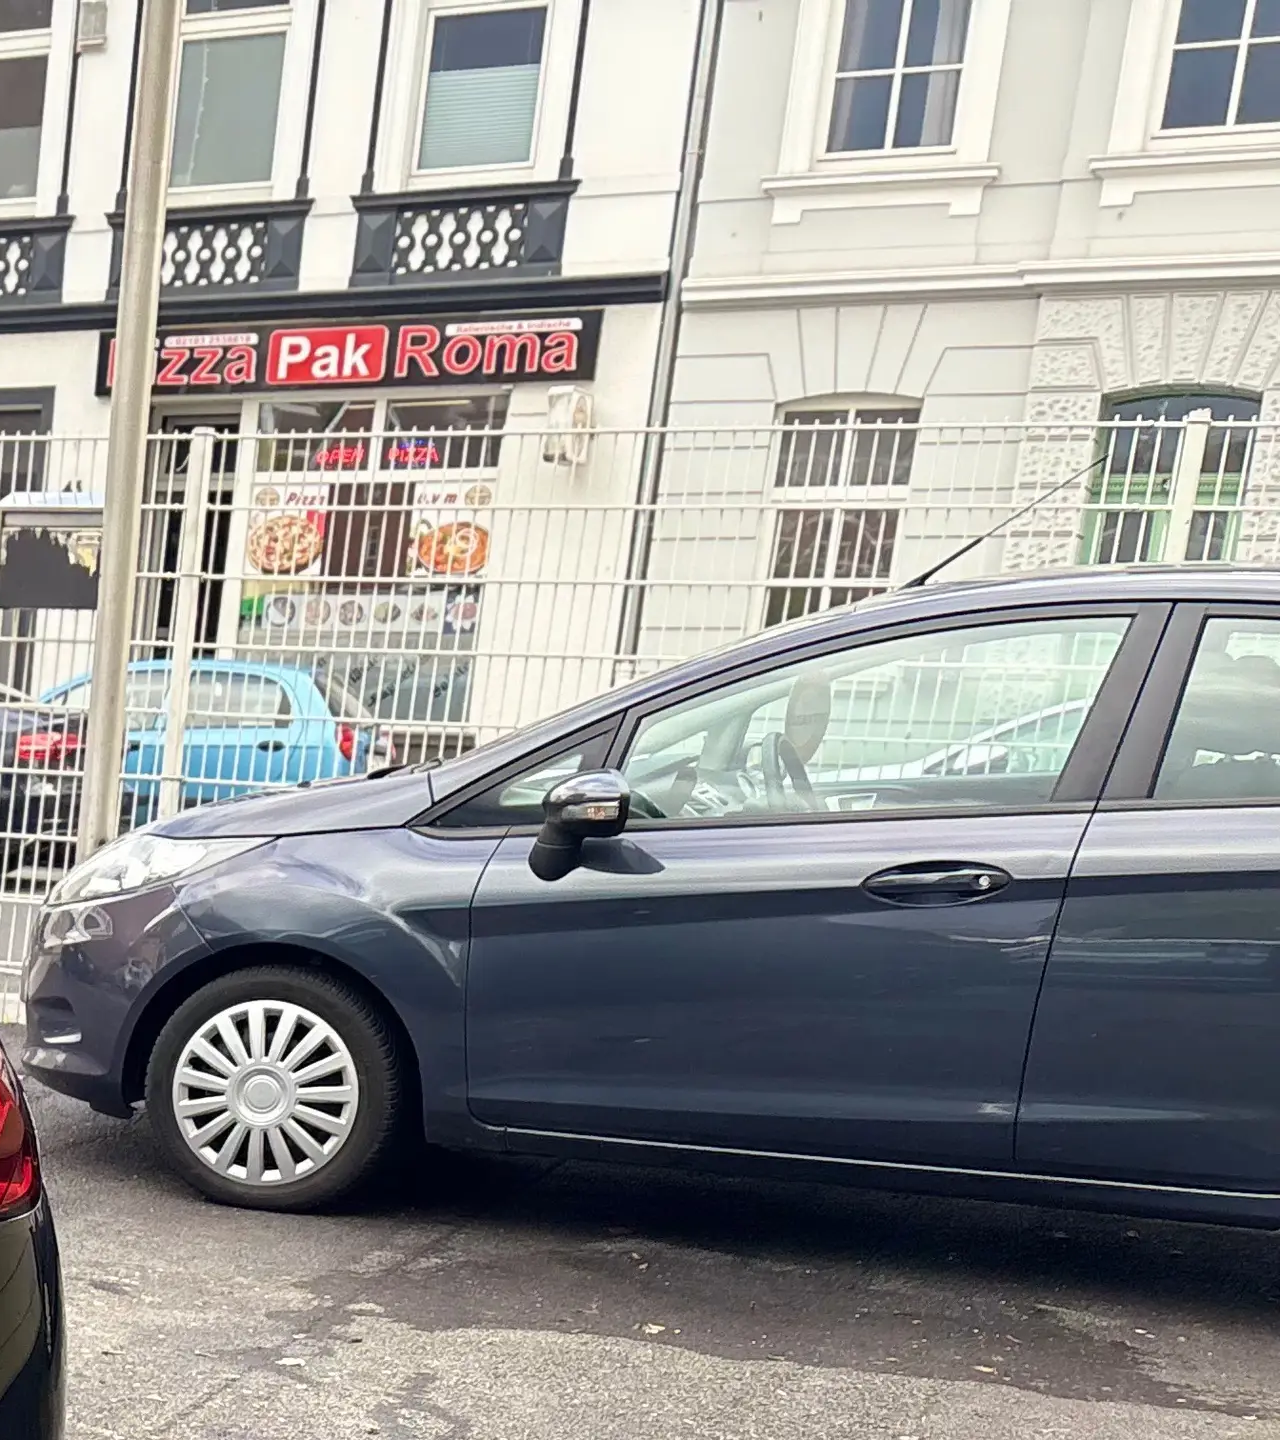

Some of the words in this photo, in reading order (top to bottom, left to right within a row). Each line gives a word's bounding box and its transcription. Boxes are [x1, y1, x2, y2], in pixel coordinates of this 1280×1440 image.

[517, 322, 525, 331] &
[277, 332, 373, 380] Pak
[394, 325, 579, 378] Roma
[316, 447, 364, 464] OPEN
